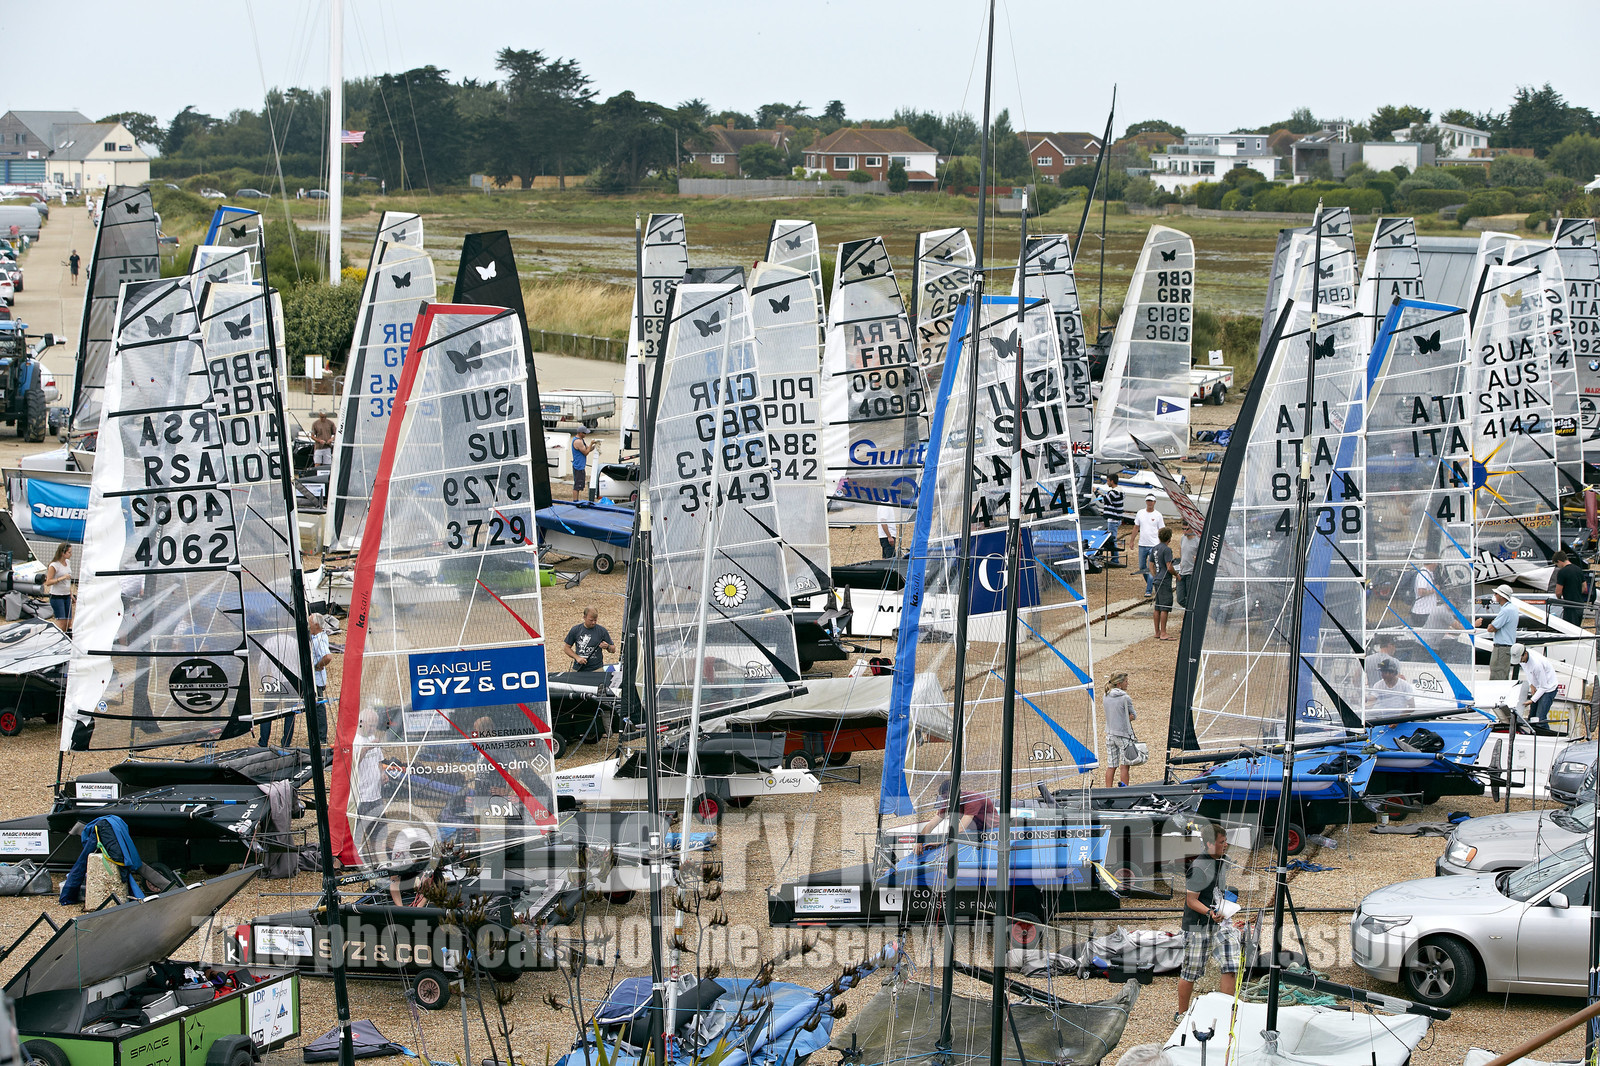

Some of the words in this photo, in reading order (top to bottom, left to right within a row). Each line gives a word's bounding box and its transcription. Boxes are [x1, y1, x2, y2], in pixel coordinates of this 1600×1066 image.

[1158, 288, 1191, 303] GBR
[1146, 324, 1189, 342] 3613
[861, 343, 911, 367] FRA
[1488, 363, 1540, 391] AUS
[213, 381, 278, 416] GBR
[858, 392, 921, 417] 4090
[695, 404, 764, 442] GBR
[764, 403, 815, 426] POL
[993, 404, 1063, 448] SUI
[1483, 413, 1541, 439] 4142
[468, 429, 520, 463] SUI
[849, 438, 926, 466] Gurit
[1276, 436, 1334, 468] ITA
[1412, 425, 1469, 457] ITA
[144, 451, 216, 487] RSA
[679, 472, 770, 512] 3943
[970, 482, 1071, 528] 4144
[1275, 505, 1361, 536] 438
[1436, 495, 1466, 522] 41
[446, 515, 526, 550] 3729
[134, 532, 230, 567] 4062
[416, 660, 492, 676] BANQUE
[418, 675, 471, 697] SYZ
[478, 676, 496, 692] &
[501, 671, 540, 691] CO
[885, 892, 896, 906] G
[373, 944, 390, 962] &
[396, 943, 432, 964] CO
[253, 989, 266, 1004] LDP
[130, 1036, 170, 1059] SPACE
